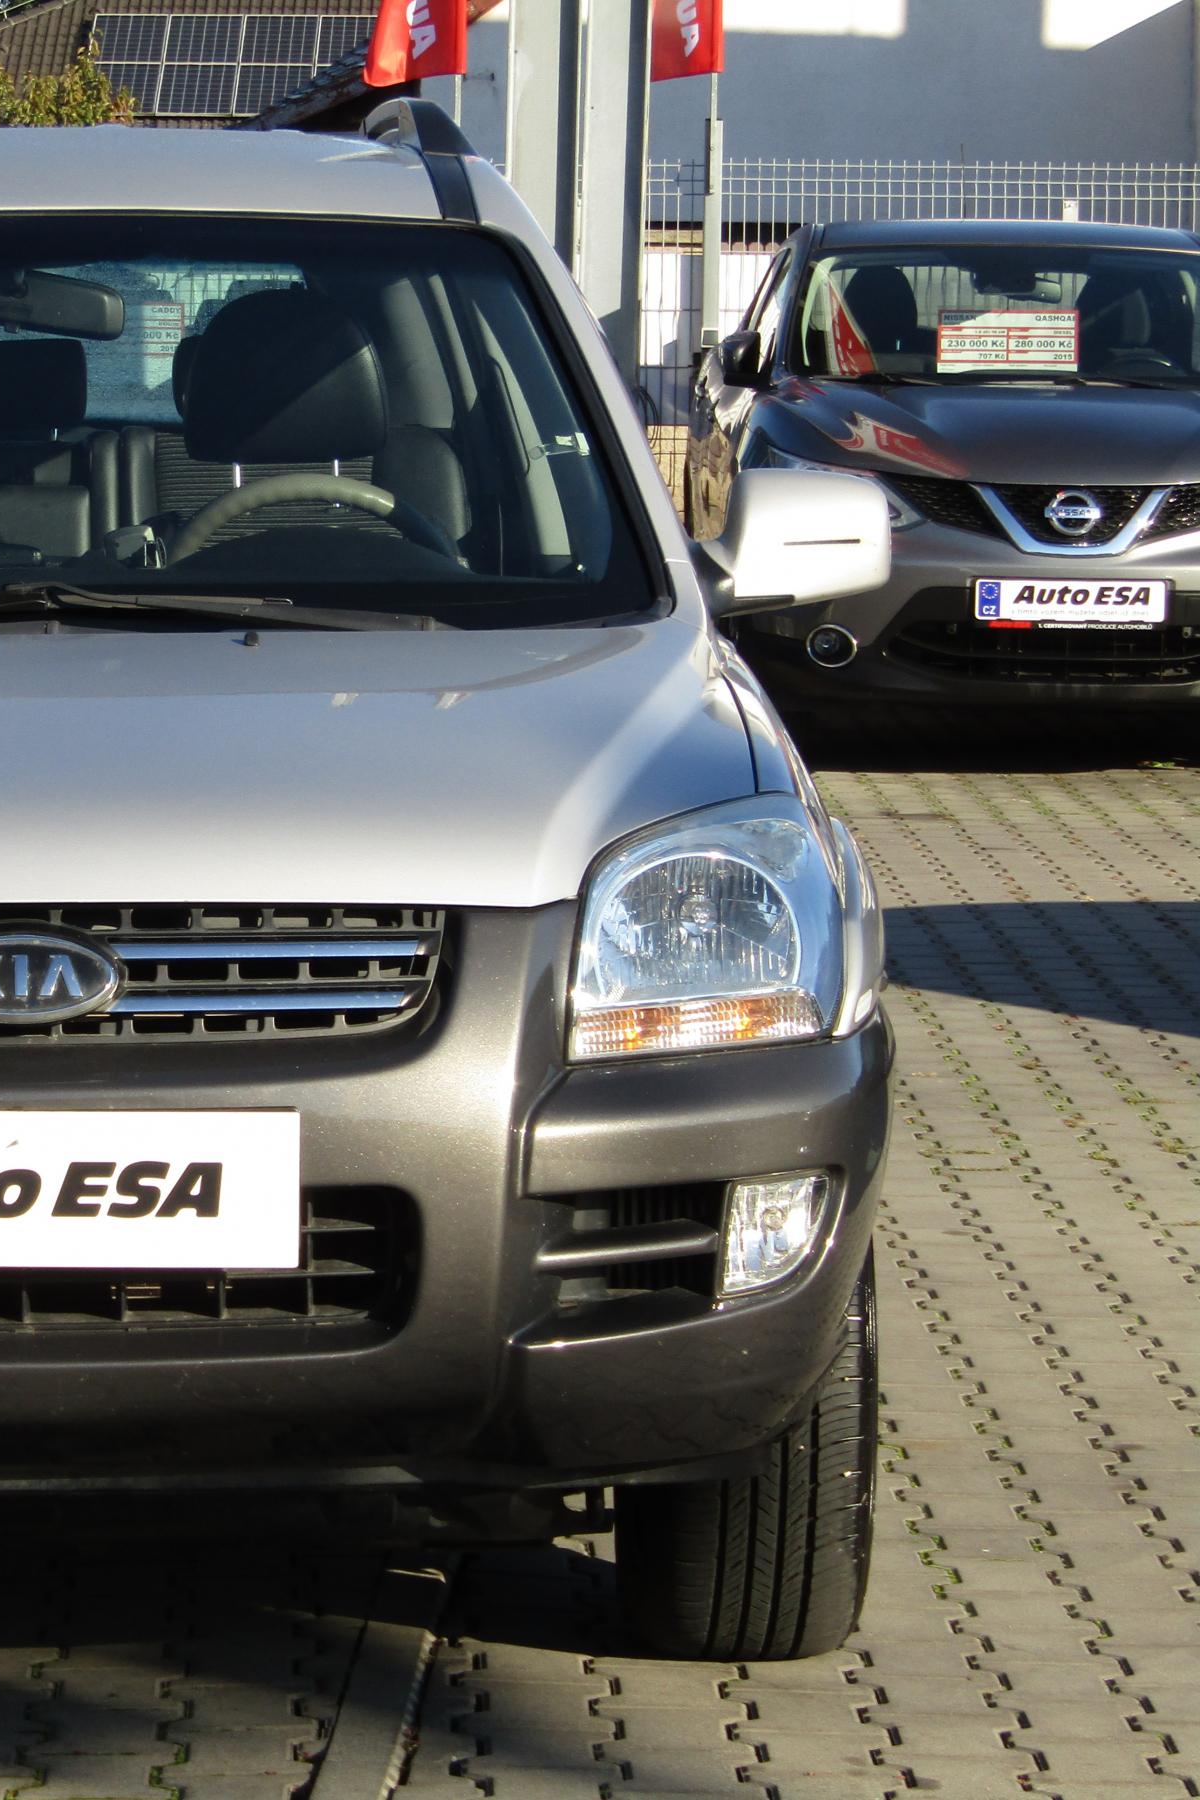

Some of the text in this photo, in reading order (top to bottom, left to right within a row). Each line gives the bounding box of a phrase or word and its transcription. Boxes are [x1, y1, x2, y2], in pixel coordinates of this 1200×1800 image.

[1035, 314, 1075, 322] QASHQAI
[948, 339, 1005, 348] 230 000 Kč
[1014, 340, 1073, 349] 280 000 Kč
[1013, 585, 1151, 606] Auto ESA
[982, 605, 996, 615] CZ
[51, 1161, 223, 1219] ESA
